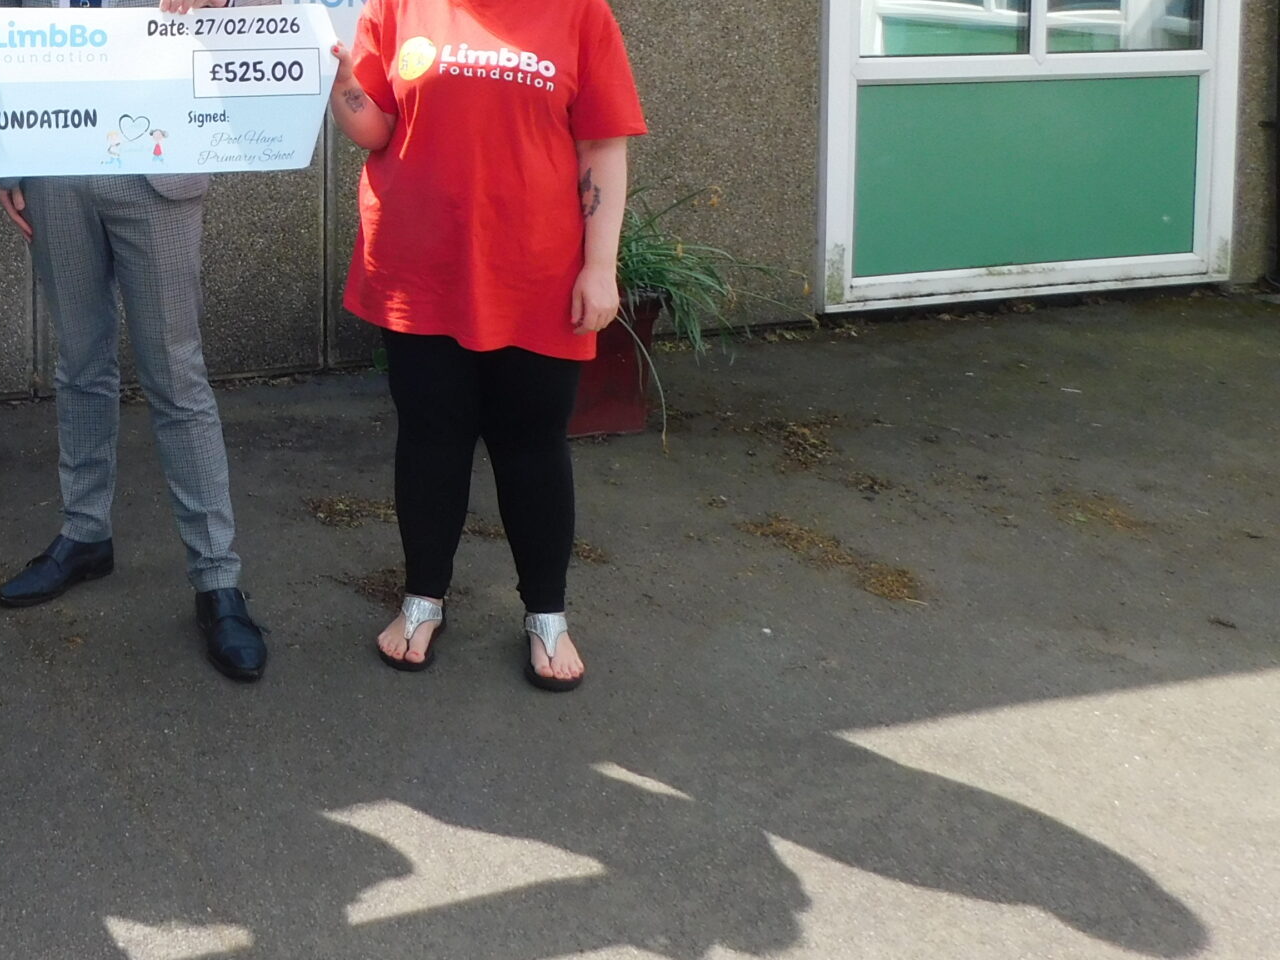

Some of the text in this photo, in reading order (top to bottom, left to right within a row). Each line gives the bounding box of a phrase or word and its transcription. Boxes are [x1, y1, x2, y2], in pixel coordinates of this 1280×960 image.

[147, 17, 301, 37] Date: 27/02/2026
[441, 43, 556, 77] LimbBo
[209, 60, 304, 83] £525.00
[439, 63, 555, 92] Foundation
[188, 110, 230, 128] Signed:
[210, 129, 284, 147] Pool Hayes
[198, 147, 295, 165] Primary School
